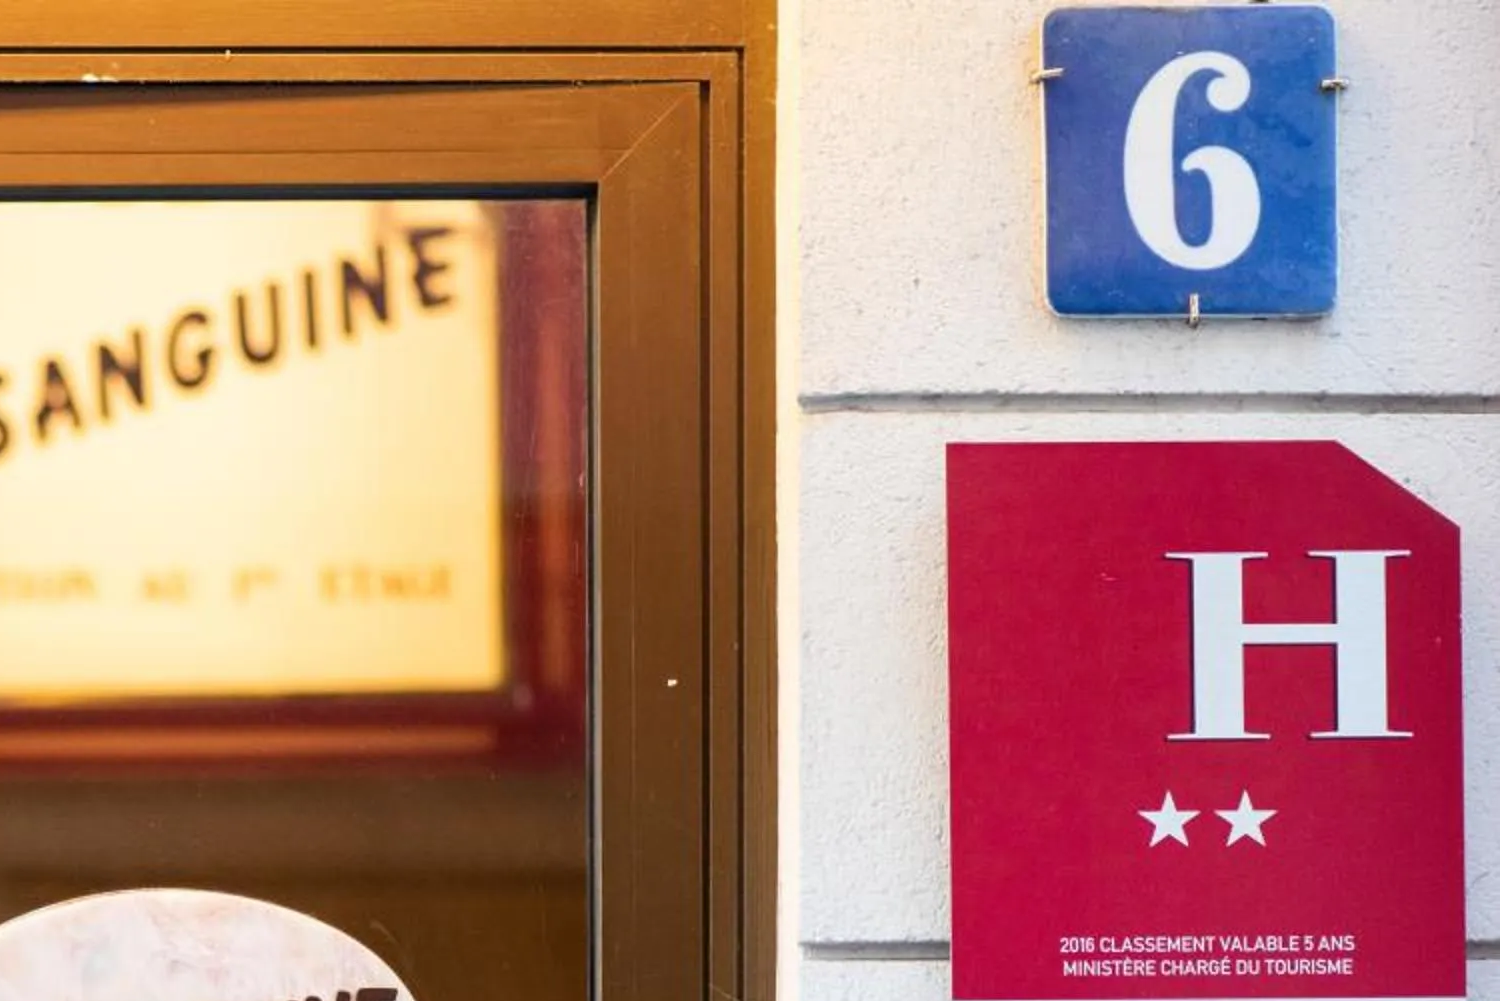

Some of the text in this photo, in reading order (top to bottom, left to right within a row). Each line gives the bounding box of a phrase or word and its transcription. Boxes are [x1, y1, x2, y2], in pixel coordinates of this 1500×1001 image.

[1123, 51, 1261, 270] 6
[1165, 549, 1414, 740] H
[1060, 935, 1355, 953] 2016 CLASSEMENT VALABLE 5 ANS
[1063, 955, 1353, 976] MINISTÈRE CHARGÉ DU TOURISME
